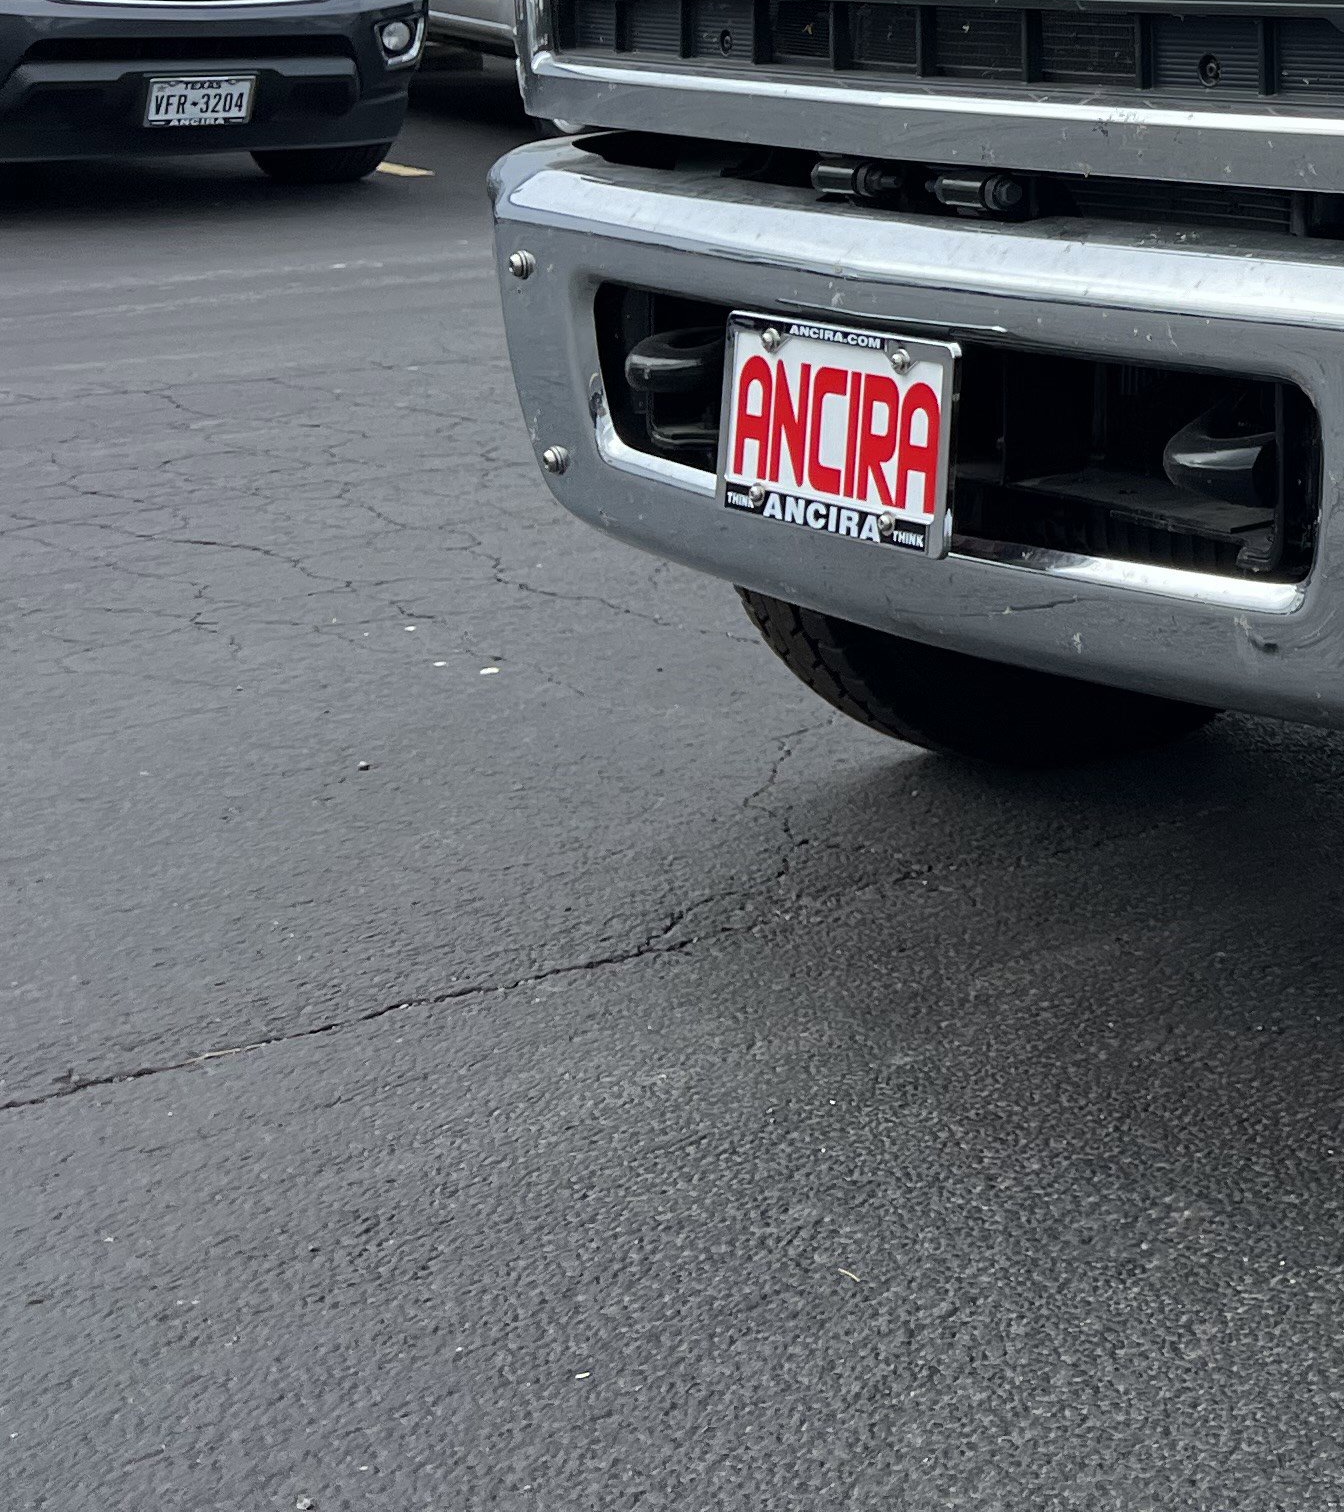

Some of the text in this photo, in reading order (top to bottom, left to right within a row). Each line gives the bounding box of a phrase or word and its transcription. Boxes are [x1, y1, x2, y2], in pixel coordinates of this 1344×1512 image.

[789, 324, 881, 350] ANCIRA.COM
[733, 355, 941, 515] ANCIRA
[762, 492, 881, 543] ANCIRA
[892, 530, 924, 548] THINK
